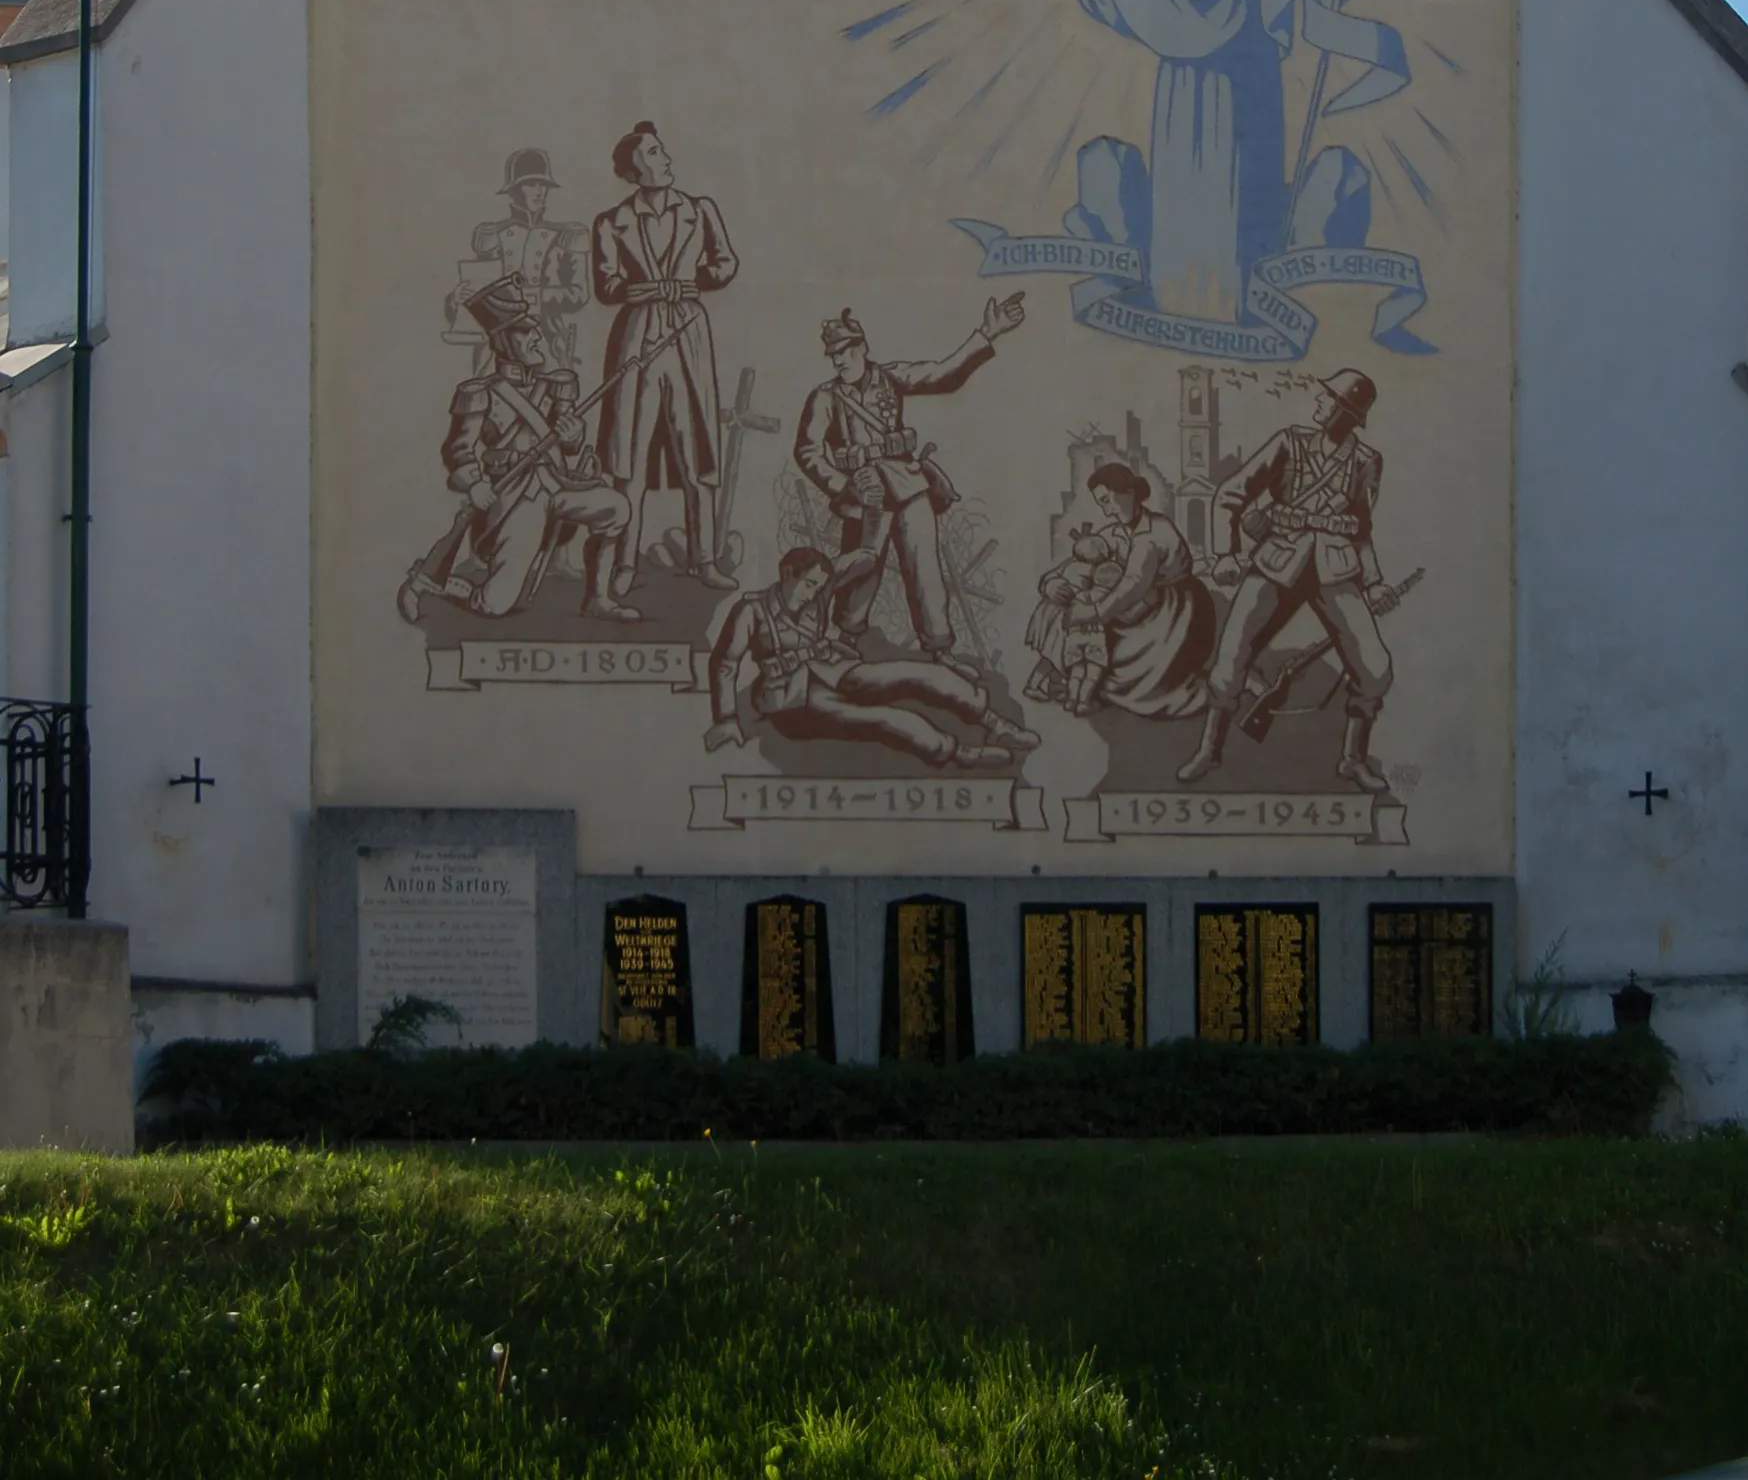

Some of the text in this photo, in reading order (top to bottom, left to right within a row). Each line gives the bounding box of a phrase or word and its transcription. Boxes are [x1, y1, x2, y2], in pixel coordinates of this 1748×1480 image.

[1001, 243, 1131, 272] ICH BIN DIE
[1265, 254, 1408, 285] DAS LEBEN
[1257, 290, 1306, 332] UND
[1095, 299, 1280, 357] AUFERSTEHUNG
[383, 875, 436, 893] Anton
